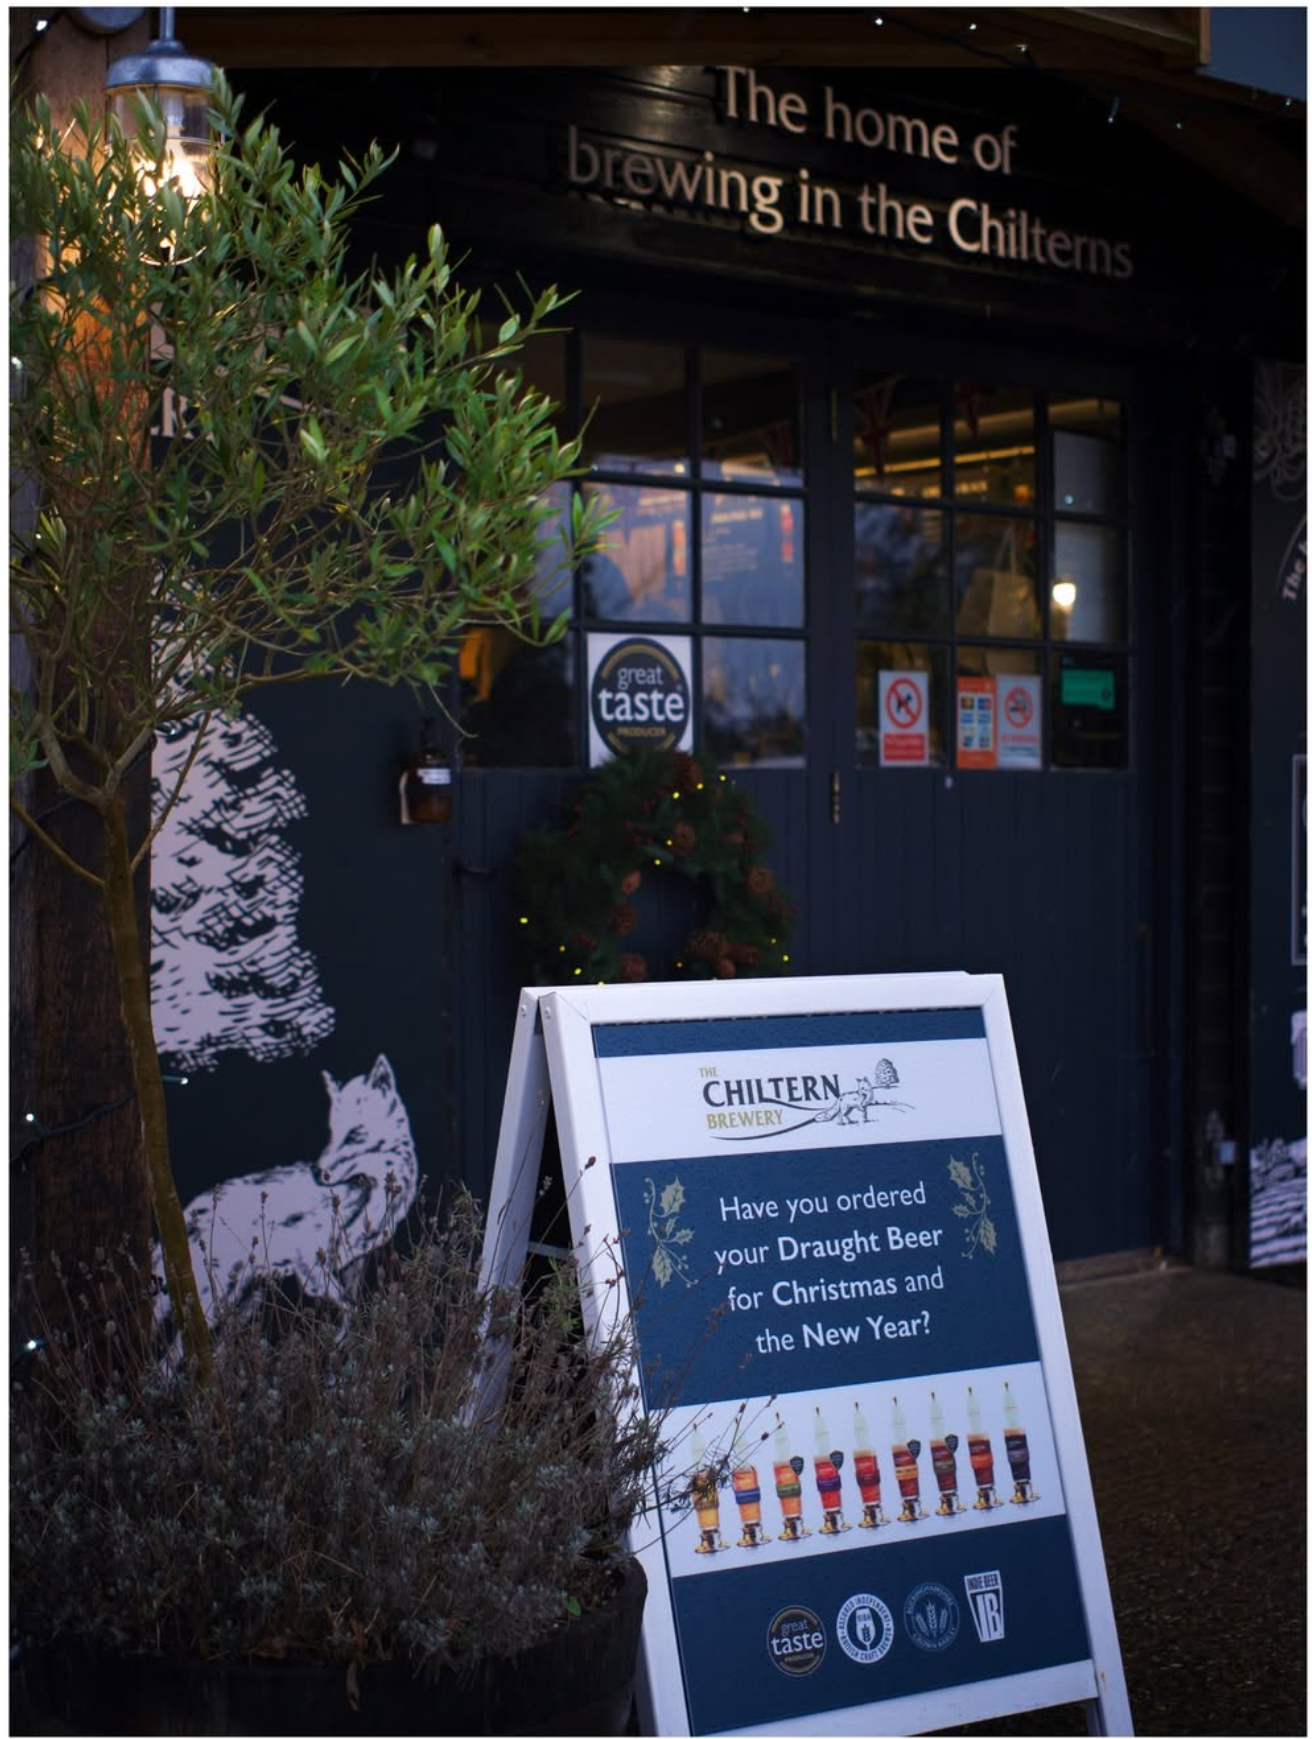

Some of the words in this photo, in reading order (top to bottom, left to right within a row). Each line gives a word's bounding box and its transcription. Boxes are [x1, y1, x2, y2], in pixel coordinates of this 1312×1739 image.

[716, 65, 807, 133] The
[825, 86, 958, 164] home
[973, 124, 1018, 175] of
[569, 125, 783, 234] brewing
[800, 168, 842, 228] in
[858, 183, 934, 244] the
[948, 198, 1134, 279] Chilterns
[617, 664, 664, 690] great
[598, 688, 685, 722] taste
[699, 1067, 718, 1078] THE
[702, 1074, 841, 1107] CHILTERN
[706, 1109, 783, 1130] BREWERY
[719, 1196, 779, 1222] Have
[785, 1198, 829, 1223] you
[836, 1180, 927, 1211] ordered
[714, 1245, 769, 1276] your
[777, 1230, 880, 1262] Draught
[886, 1225, 943, 1250] Beer
[727, 1286, 764, 1312] for
[771, 1276, 898, 1307] Christmas
[905, 1265, 944, 1292] and
[755, 1328, 795, 1355] the
[802, 1322, 861, 1349] New
[865, 1310, 931, 1341] Year?
[983, 1573, 999, 1588] BEER
[771, 1631, 824, 1656] taste
[781, 1619, 808, 1637] great
